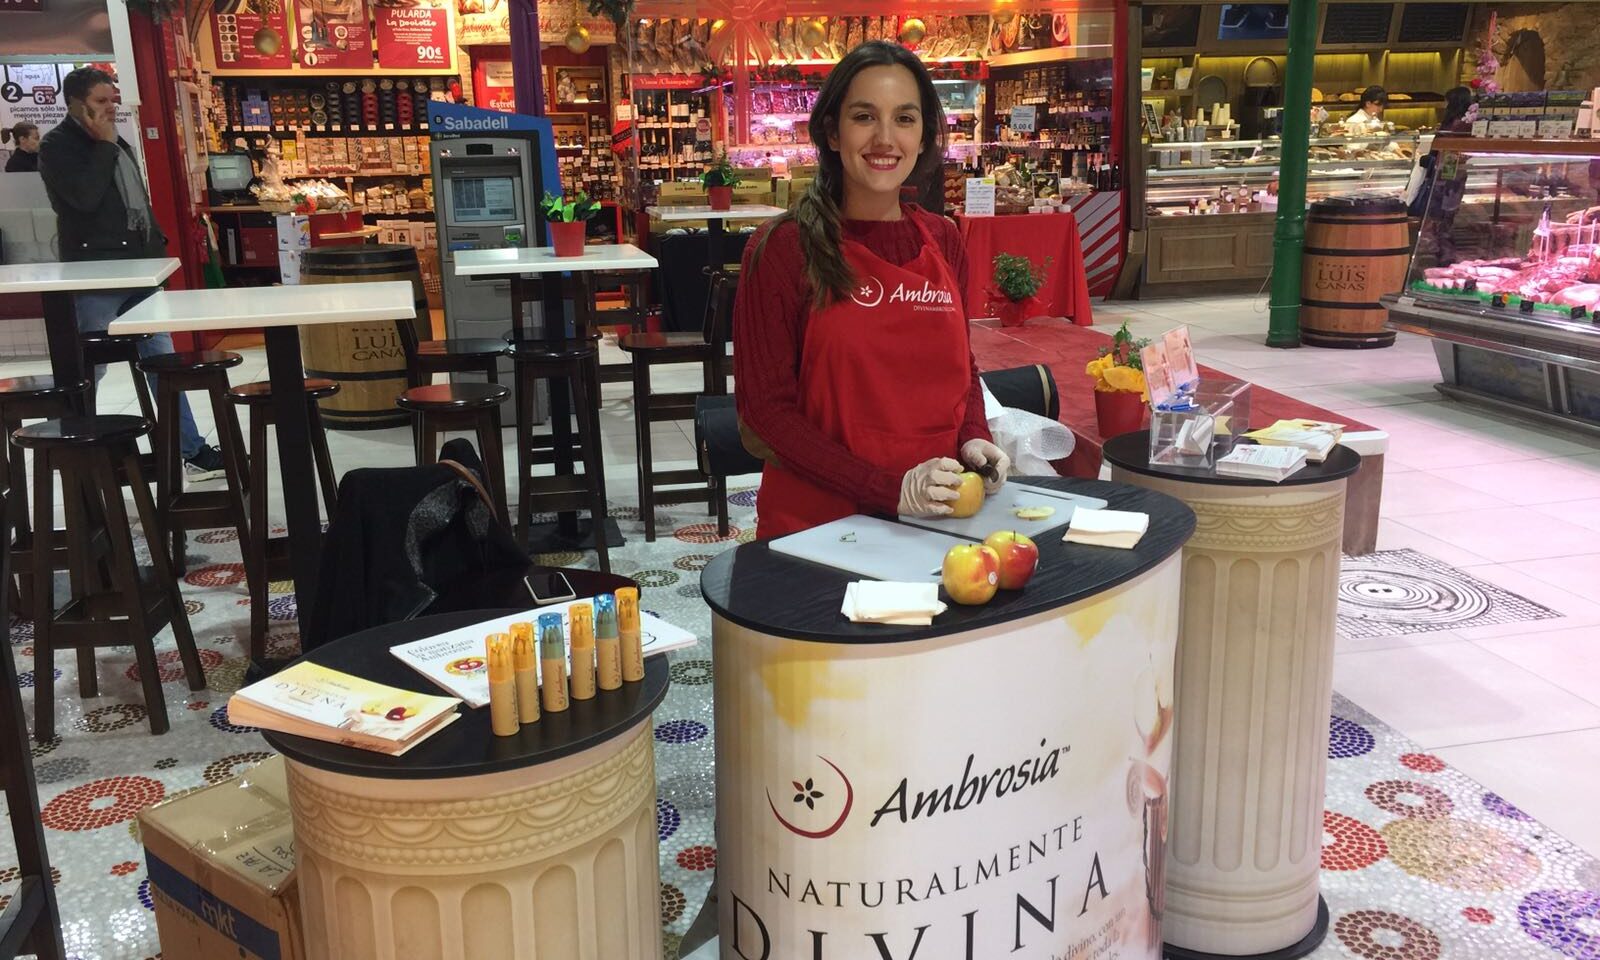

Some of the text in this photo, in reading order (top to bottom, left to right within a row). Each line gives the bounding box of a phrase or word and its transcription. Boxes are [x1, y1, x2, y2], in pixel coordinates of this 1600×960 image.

[391, 9, 431, 18] PULARDA
[387, 19, 397, 27] La
[6, 86, 18, 100] 2
[10, 106, 39, 114] picamos
[489, 99, 515, 108] Estrell
[14, 112, 41, 120] mejores
[444, 116, 509, 130] Sabadell
[354, 332, 397, 349] LUI
[870, 738, 1060, 827] Ambrosia
[768, 815, 1082, 908] NATURALMENTE
[202, 899, 237, 940] mkt
